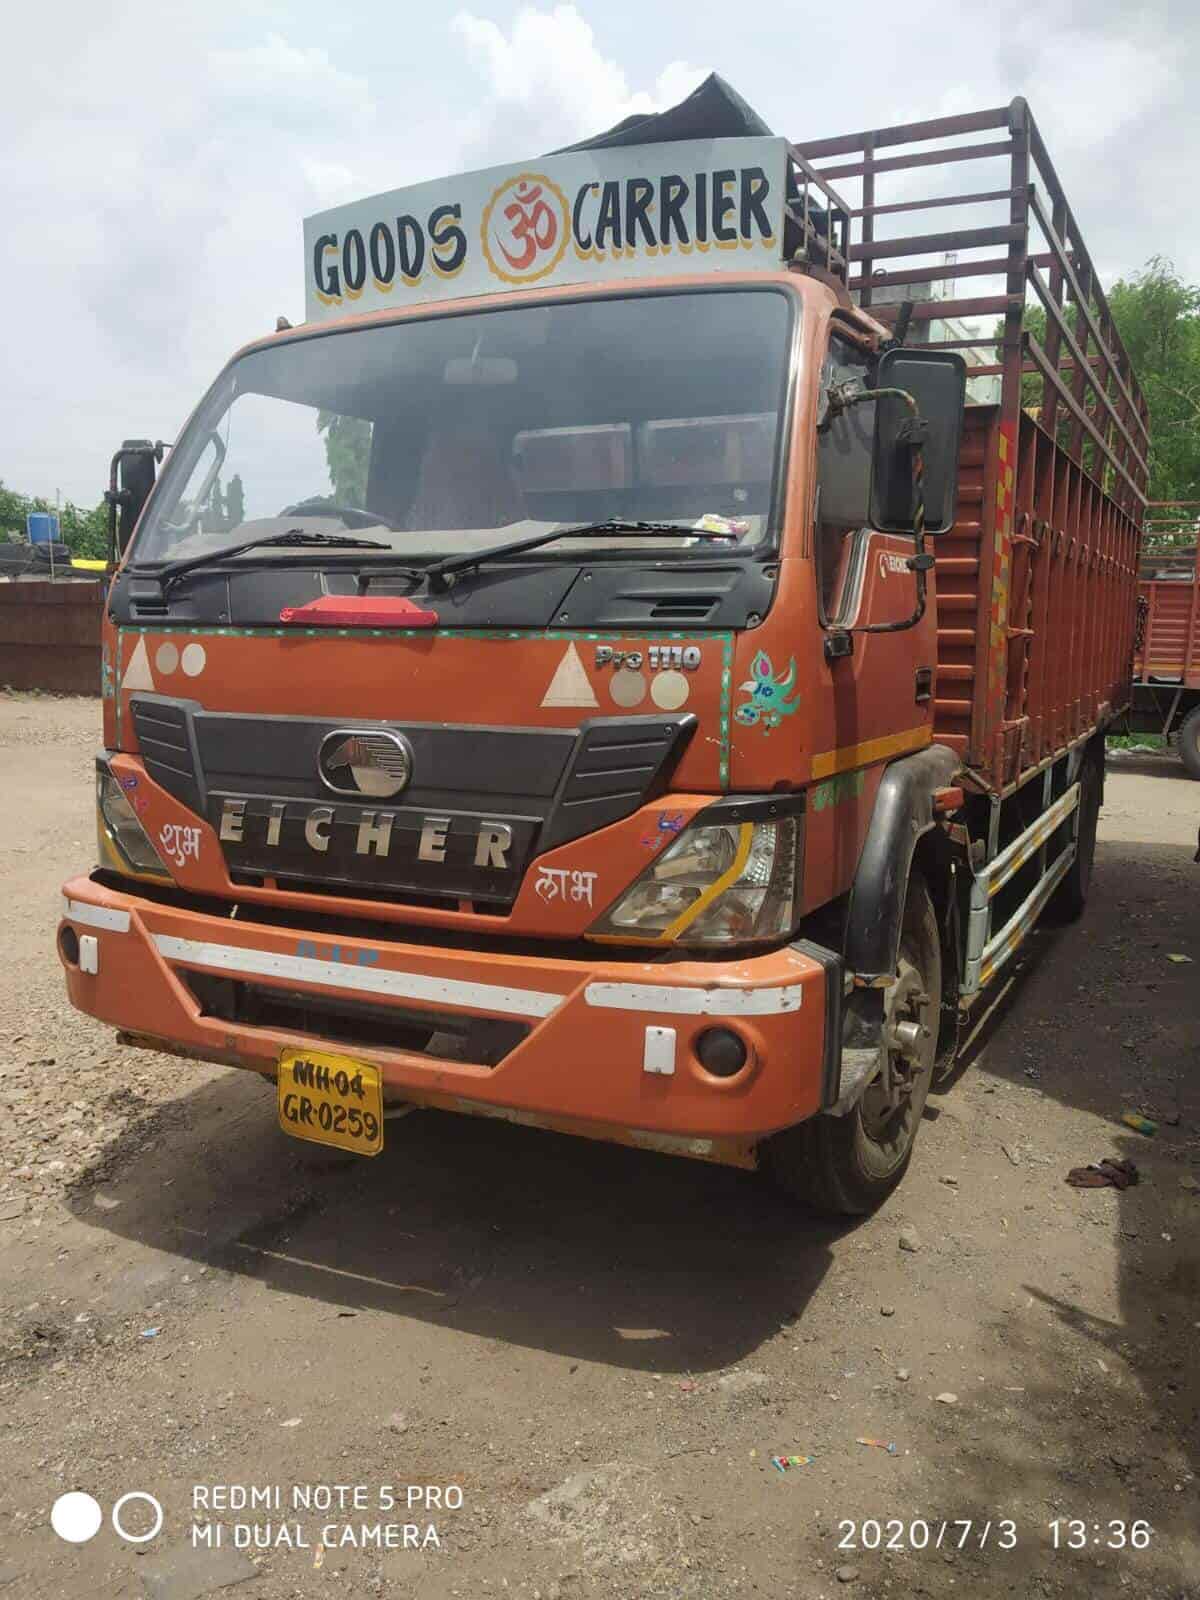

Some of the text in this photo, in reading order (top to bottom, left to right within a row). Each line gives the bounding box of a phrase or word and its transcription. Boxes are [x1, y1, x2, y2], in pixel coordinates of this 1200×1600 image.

[313, 166, 775, 301] GOODS CARRIER
[595, 645, 702, 671] Pro 1110
[159, 823, 203, 868] शुभ
[219, 799, 514, 870] EICHER
[535, 865, 599, 907] लाभ
